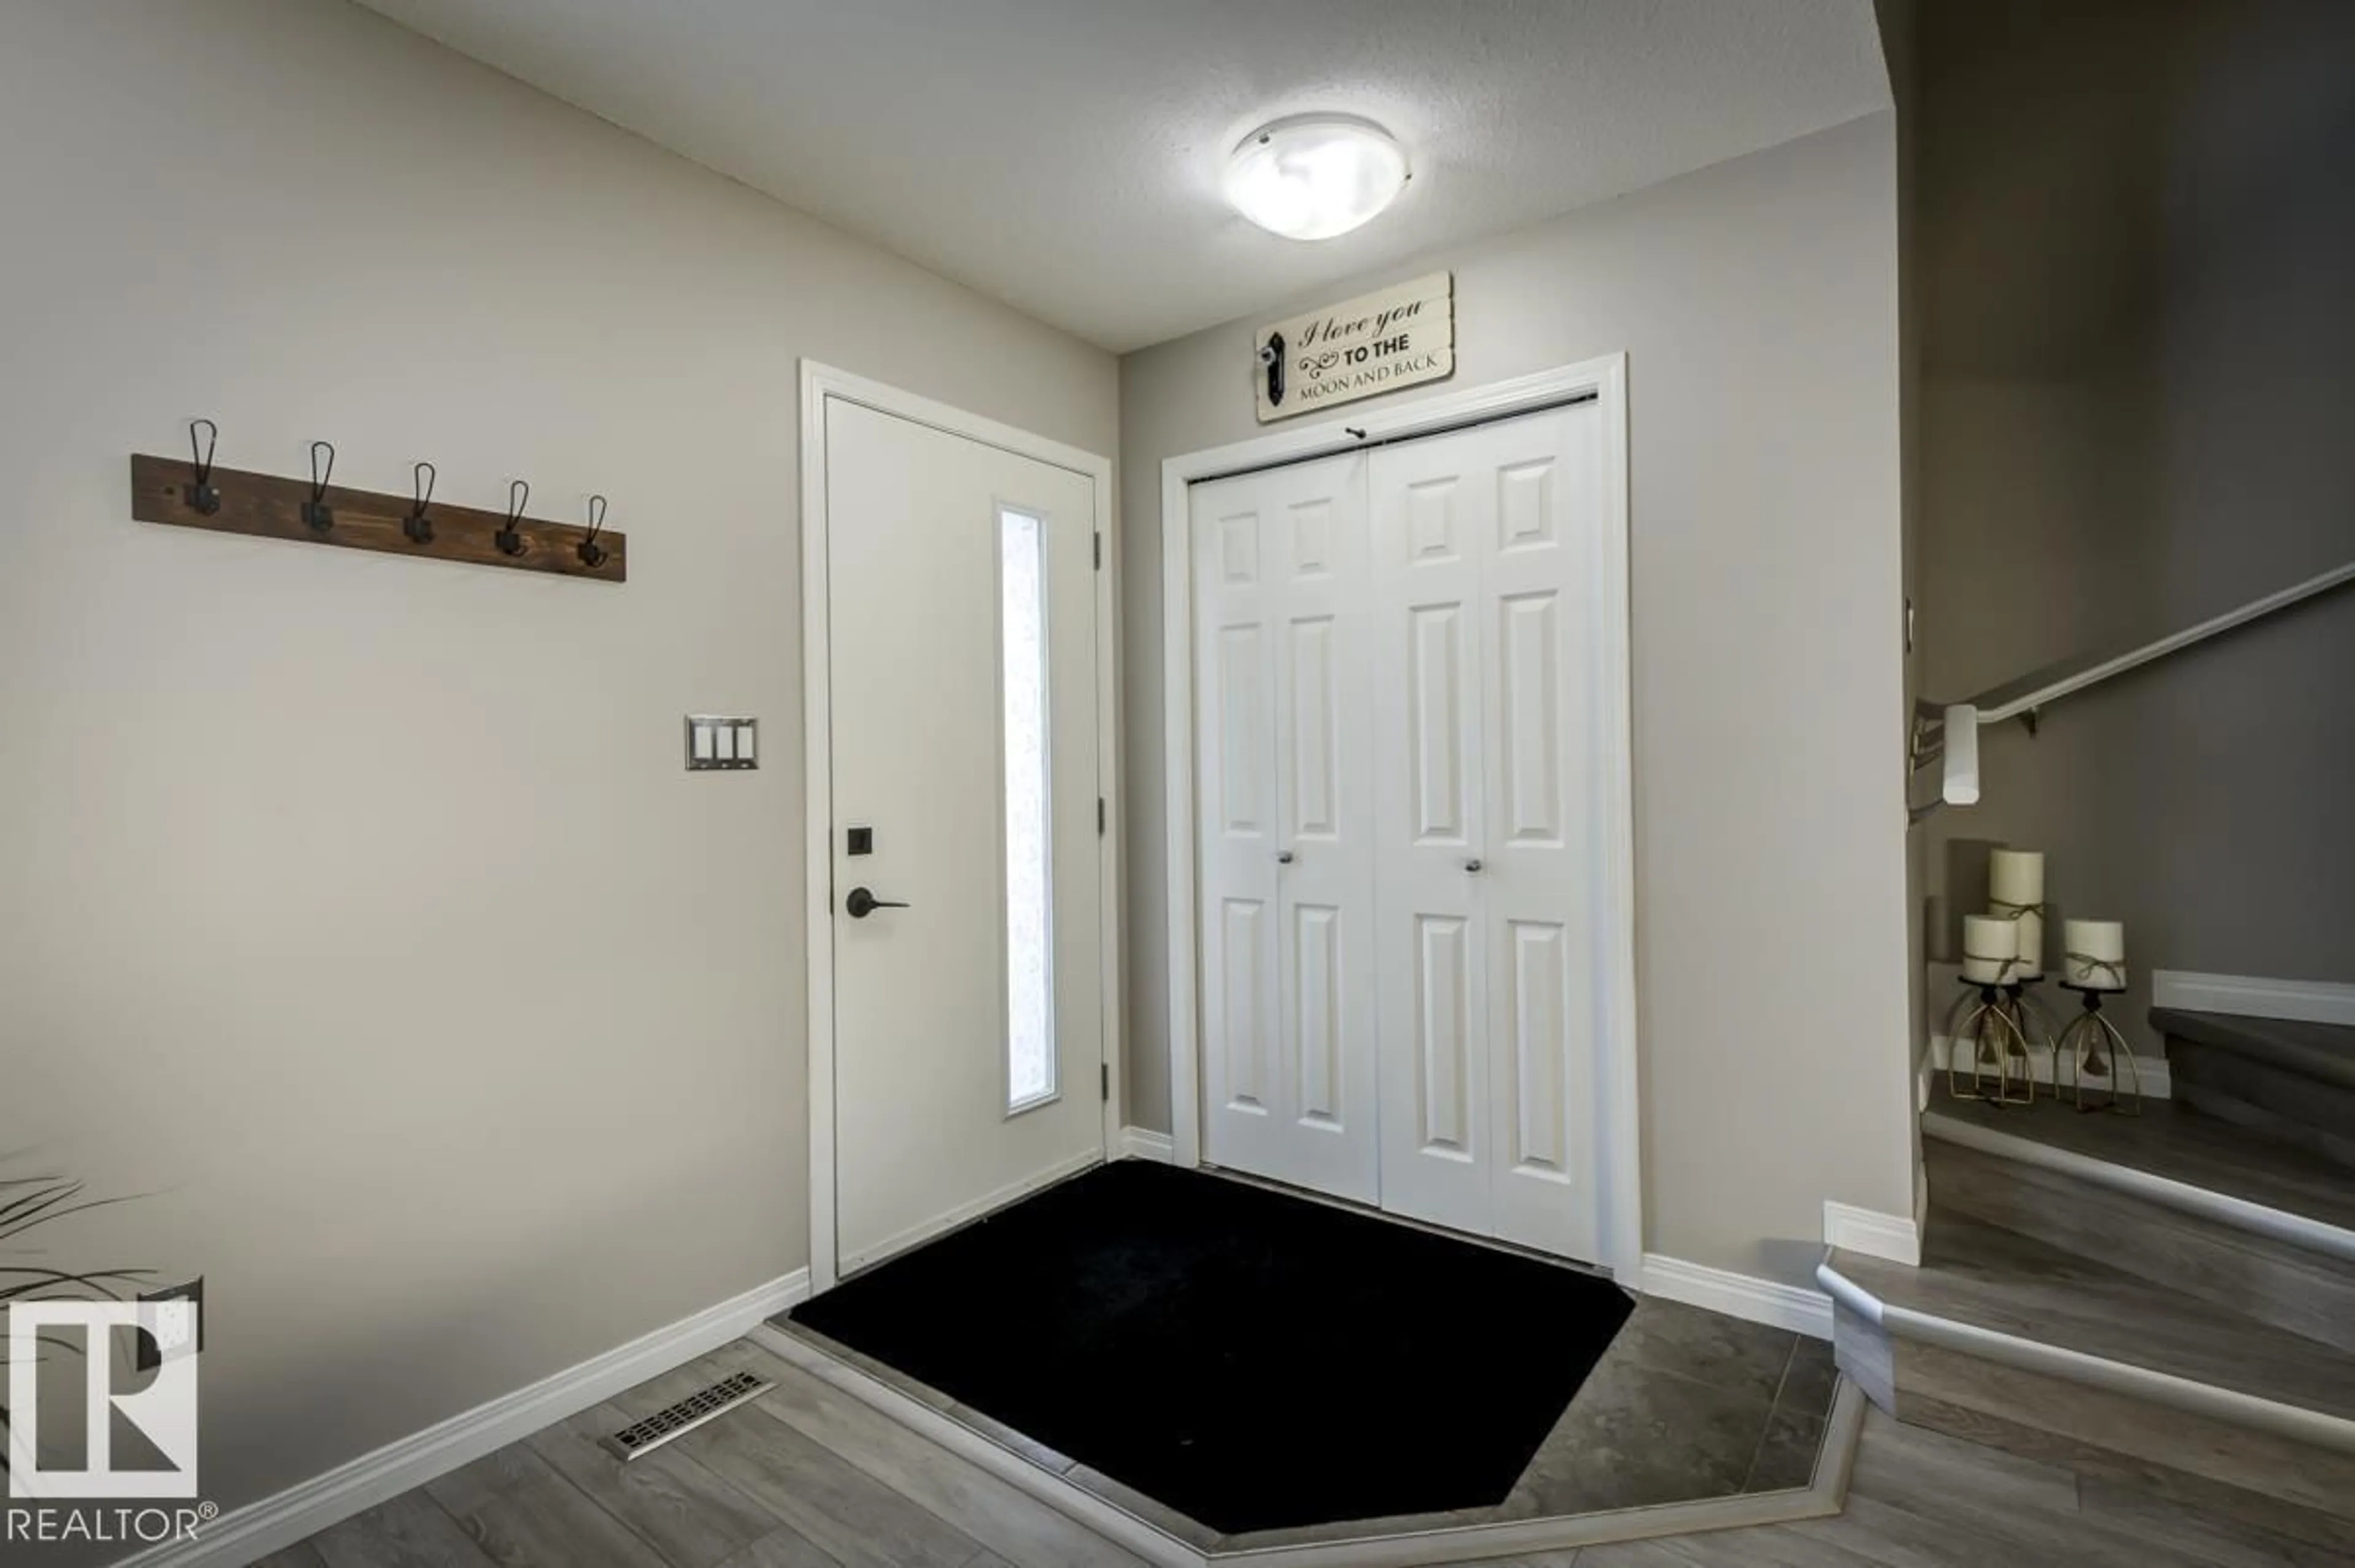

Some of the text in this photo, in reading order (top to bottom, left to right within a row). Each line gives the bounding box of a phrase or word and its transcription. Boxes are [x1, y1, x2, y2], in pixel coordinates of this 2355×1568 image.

[1298, 300, 1422, 348] I love you
[1344, 334, 1410, 366] TO THE
[1300, 354, 1437, 401] MOON AND BACK
